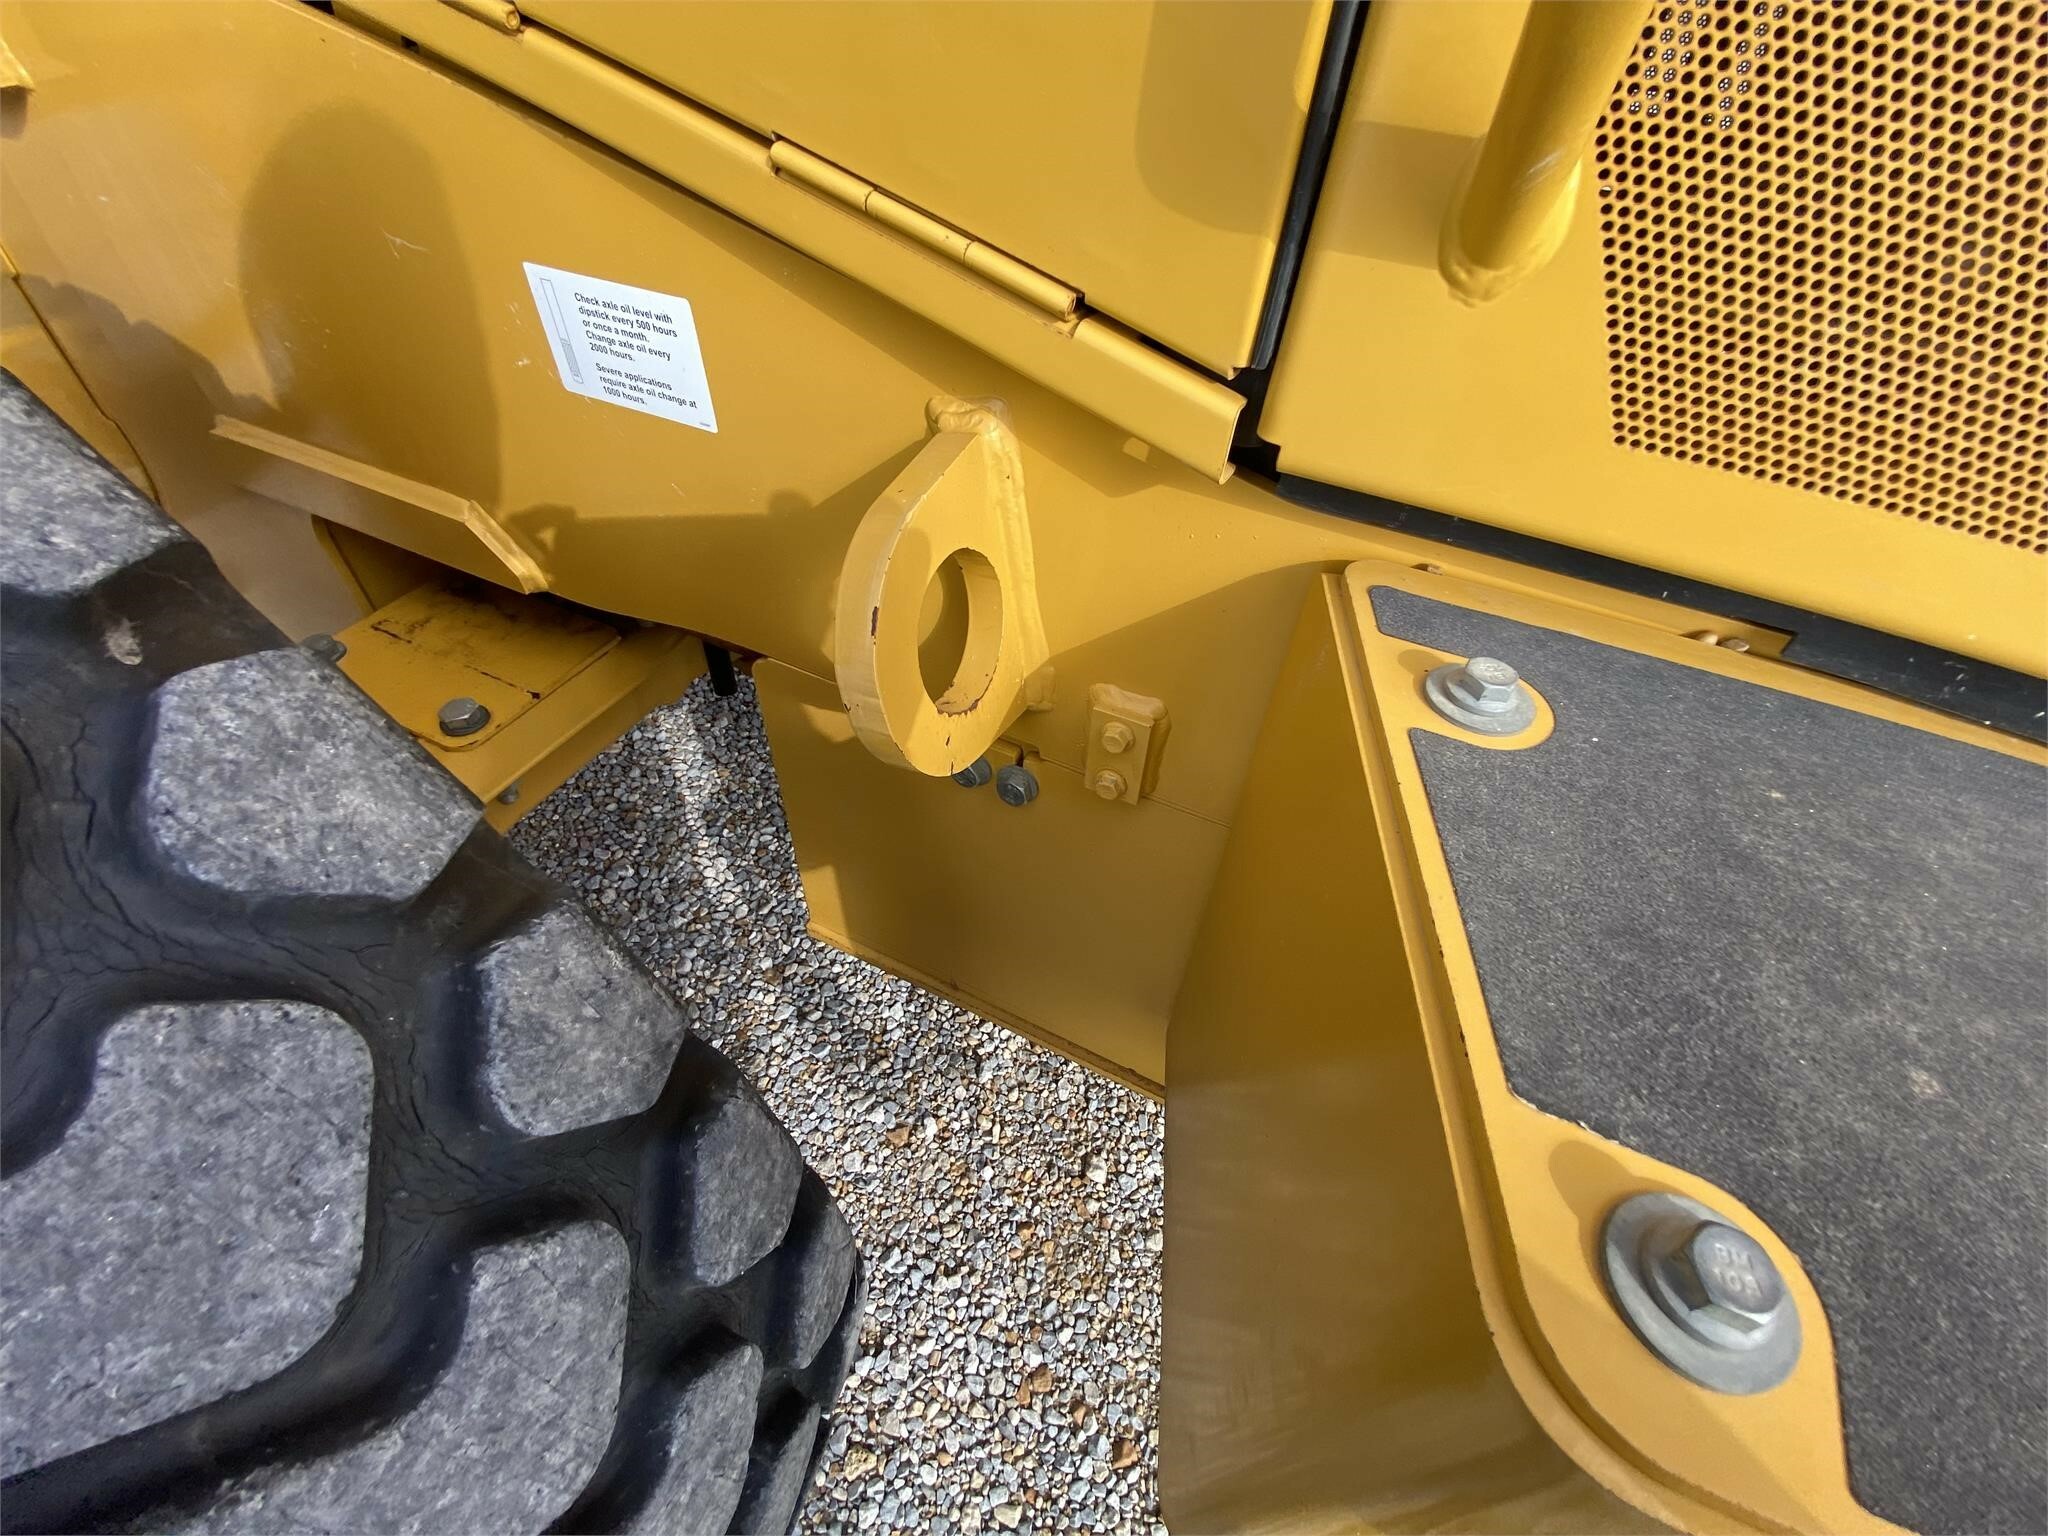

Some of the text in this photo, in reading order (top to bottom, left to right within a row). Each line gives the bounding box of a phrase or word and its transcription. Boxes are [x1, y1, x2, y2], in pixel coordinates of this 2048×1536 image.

[575, 293, 672, 324] Check axle oil level with
[579, 306, 677, 337] dipstick every 500 hours
[586, 330, 670, 361] Change axle oil every
[593, 323, 612, 332] once
[622, 330, 649, 342] month.
[590, 343, 635, 361] 2000 hours.
[596, 363, 672, 390] Severe applications
[600, 376, 626, 388] require
[629, 384, 644, 393] axle
[658, 392, 687, 406] change
[603, 386, 647, 405] 1000 hours.
